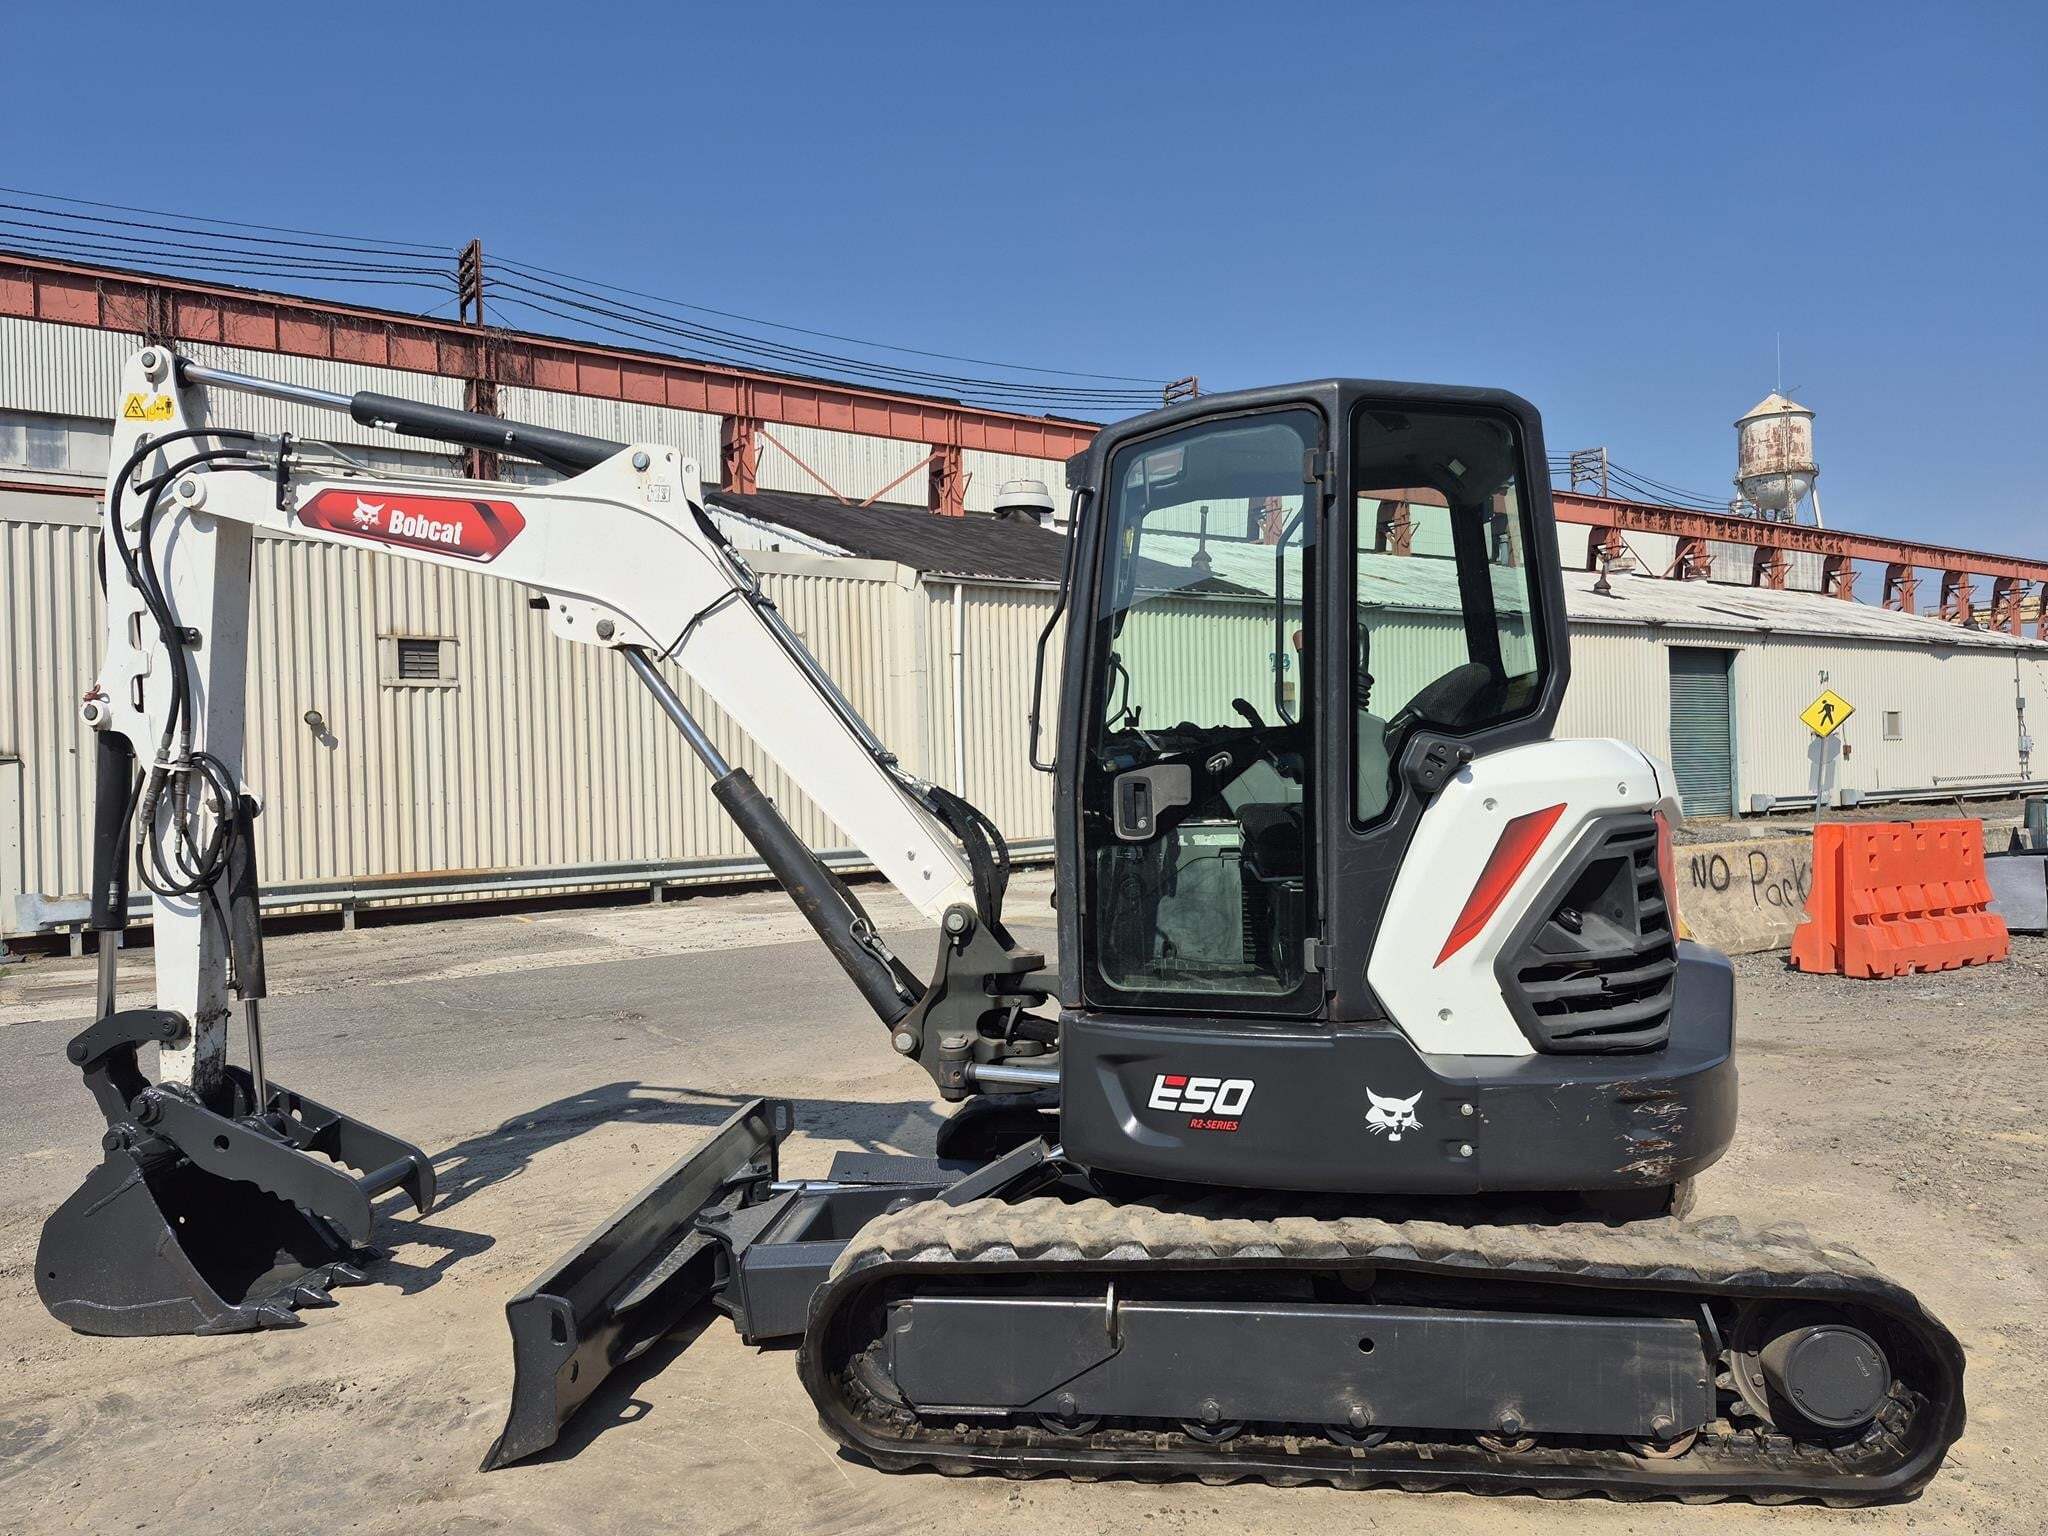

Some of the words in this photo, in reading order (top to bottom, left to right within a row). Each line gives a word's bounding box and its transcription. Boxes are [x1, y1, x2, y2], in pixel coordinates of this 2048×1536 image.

[388, 509, 463, 545] Bobcat
[1691, 854, 1730, 891] NO
[1148, 1074, 1255, 1115] E50
[1189, 1119, 1239, 1131] R2-SERIES
